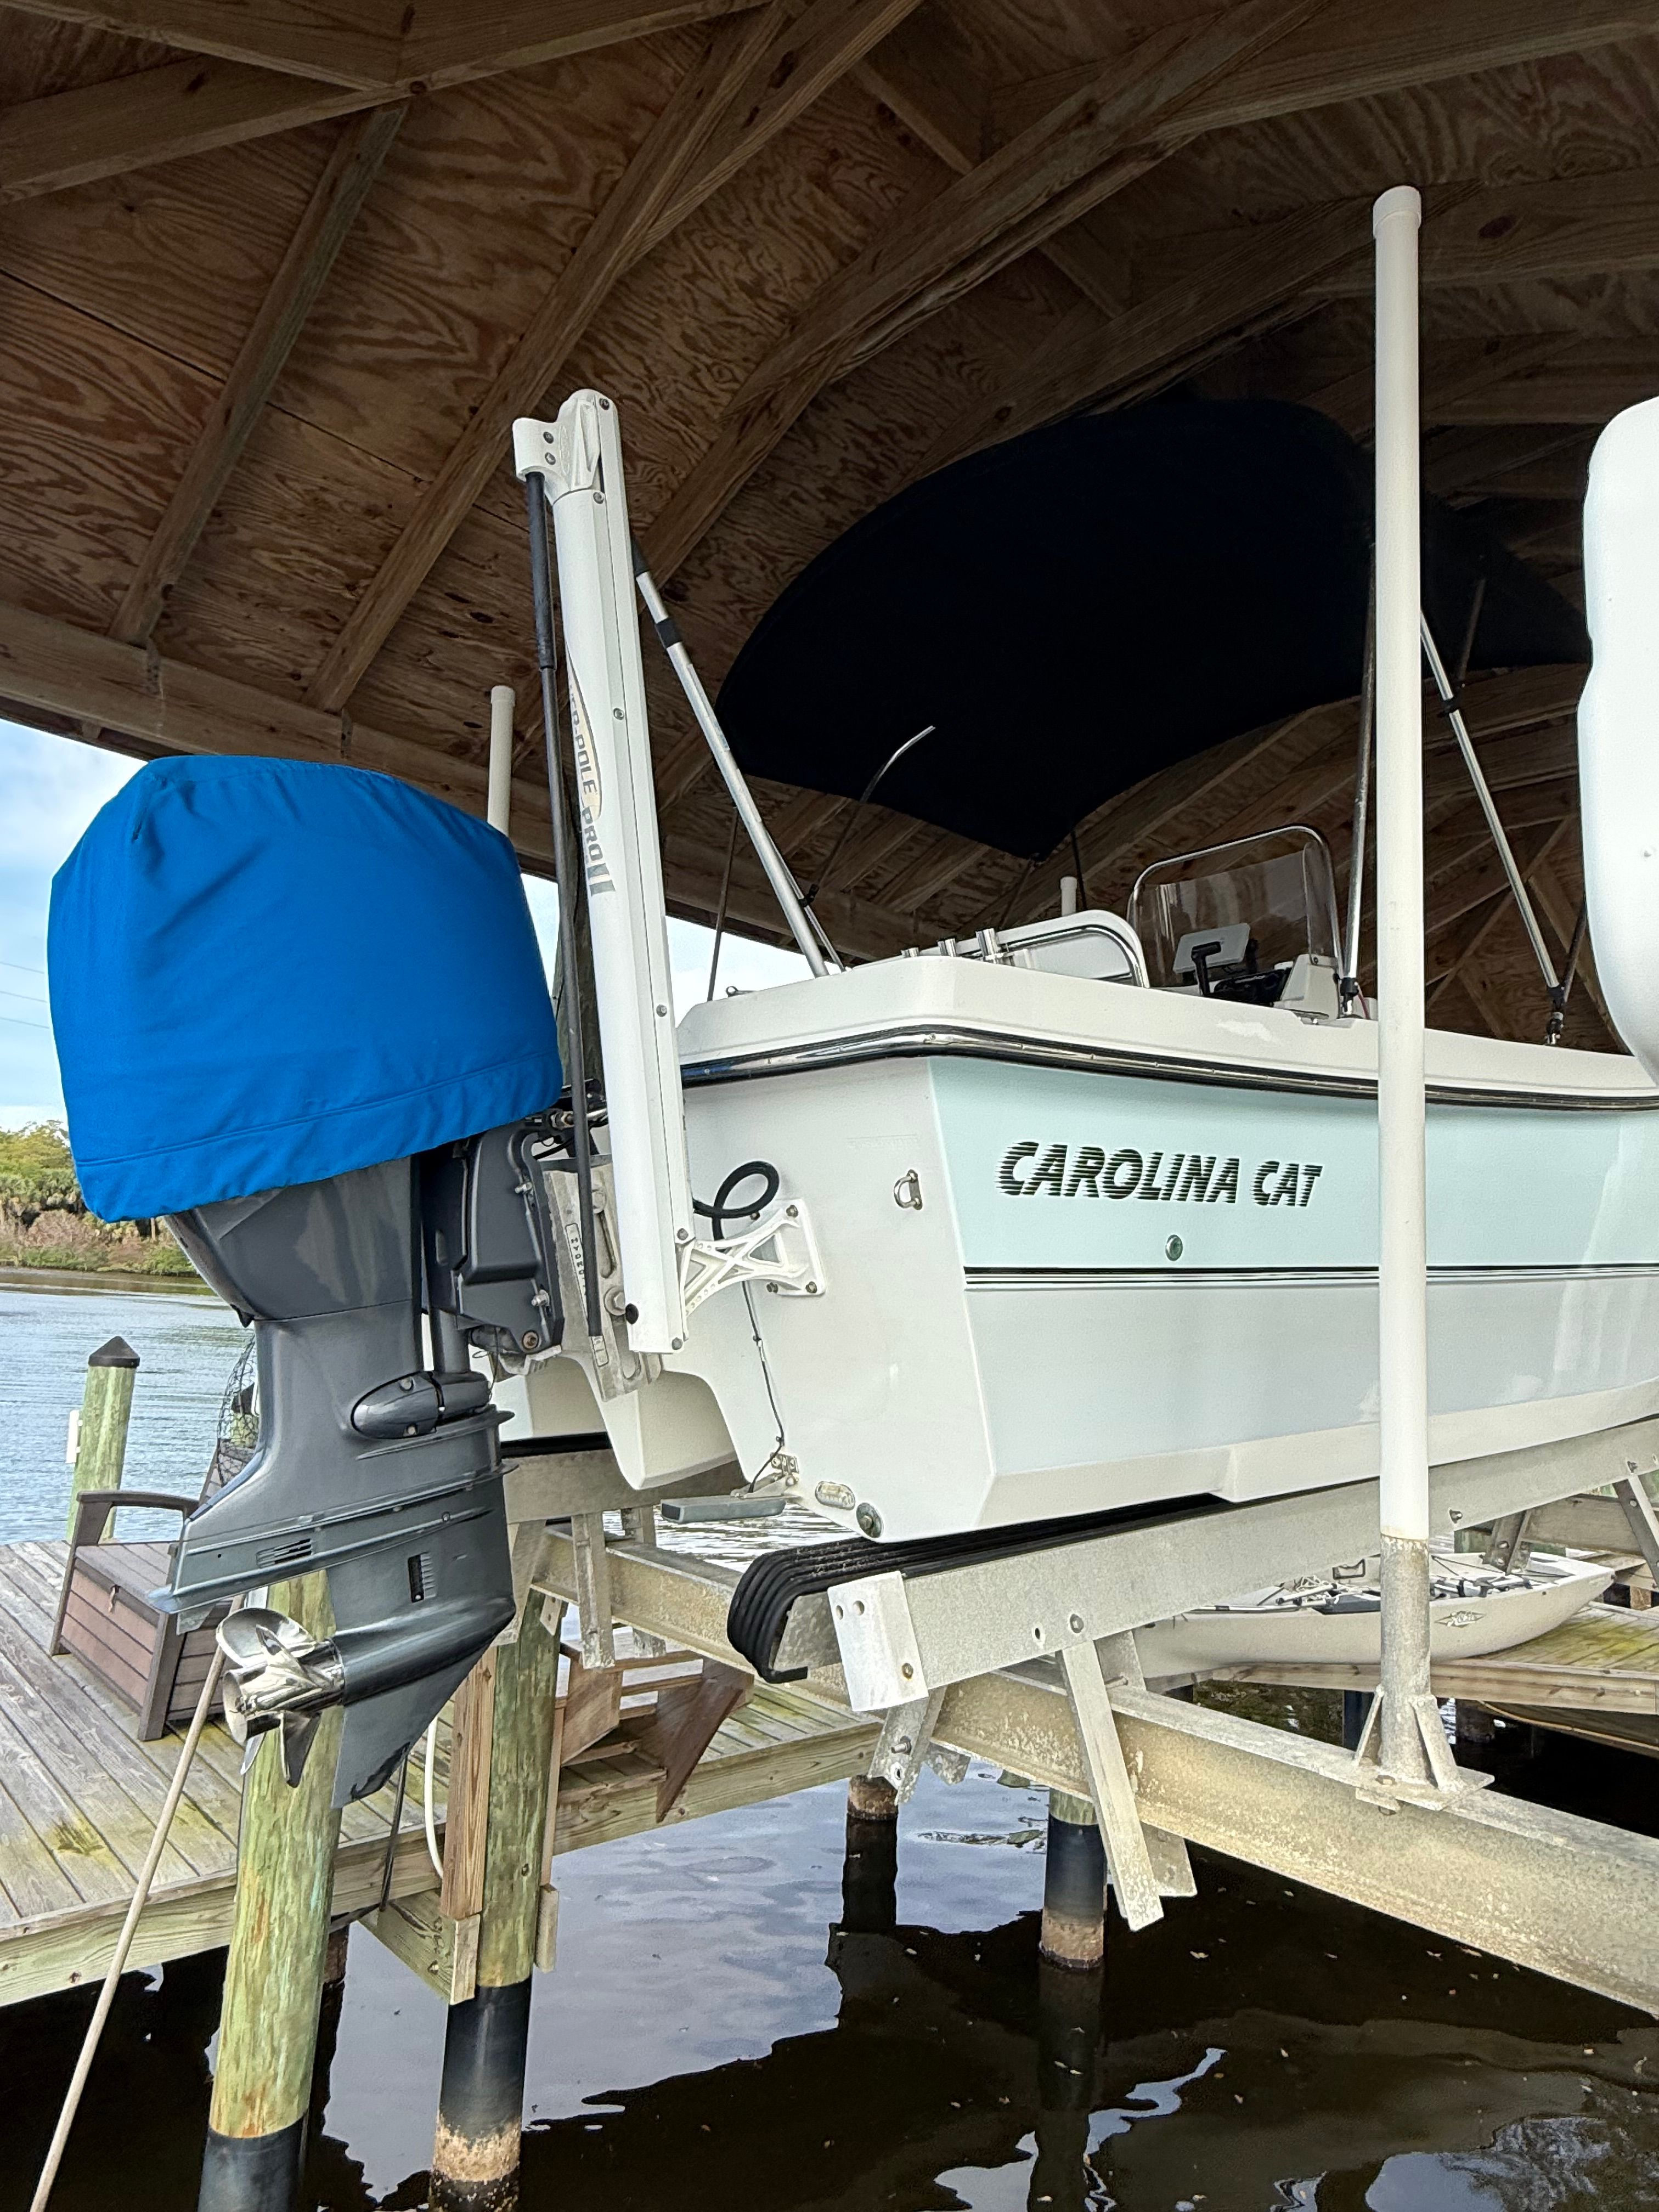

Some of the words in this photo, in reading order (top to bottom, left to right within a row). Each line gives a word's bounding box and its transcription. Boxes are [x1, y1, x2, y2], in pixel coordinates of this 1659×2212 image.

[582, 806, 603, 861] PRO
[994, 1141, 1240, 1204] CAROLINA
[1250, 1160, 1323, 1207] CAT
